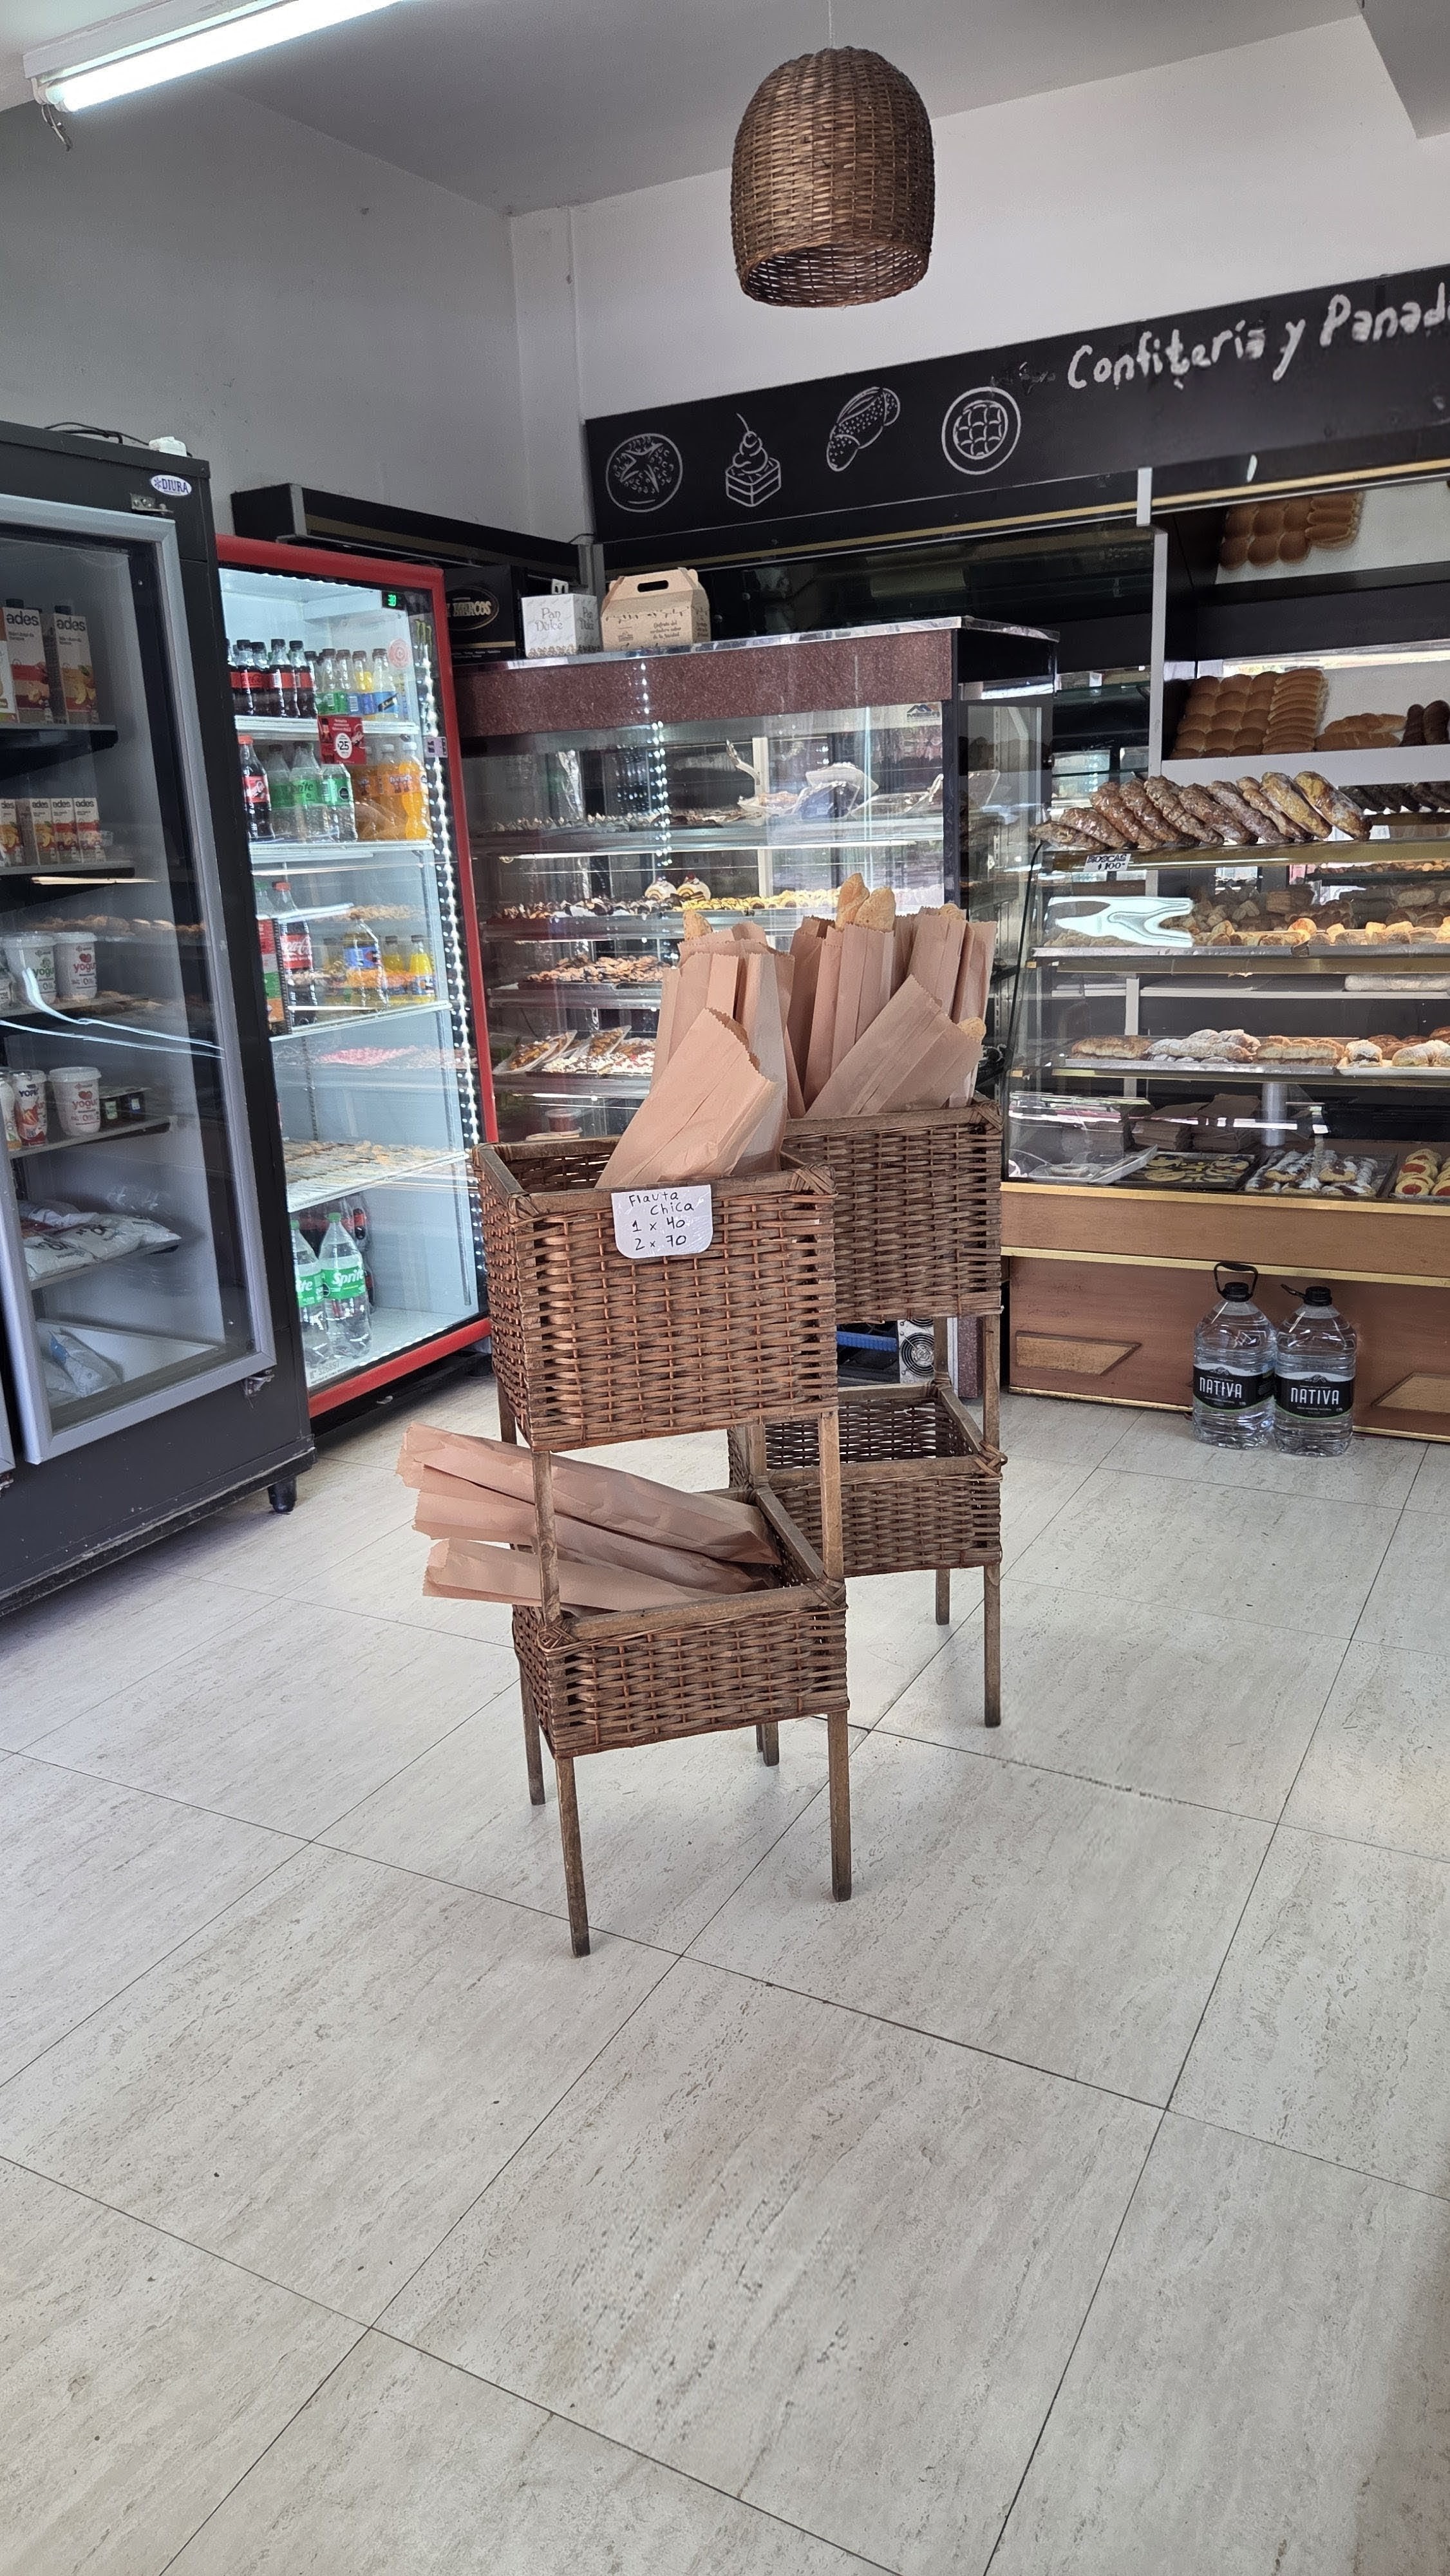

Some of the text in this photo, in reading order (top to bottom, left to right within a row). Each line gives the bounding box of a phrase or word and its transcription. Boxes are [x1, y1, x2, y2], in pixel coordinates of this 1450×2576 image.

[1272, 319, 1306, 381] y
[1320, 282, 1450, 346] Panad
[6, 611, 39, 626] ades
[541, 607, 561, 621] Pan
[57, 616, 86, 631] ades
[629, 1192, 678, 1207] Flauta
[632, 1220, 642, 1232] 1
[666, 1217, 685, 1229] 40
[635, 1238, 645, 1250] 2
[666, 1235, 686, 1247] 70
[1200, 1376, 1242, 1399] NATIVA
[1290, 1387, 1339, 1405] NATIVA
